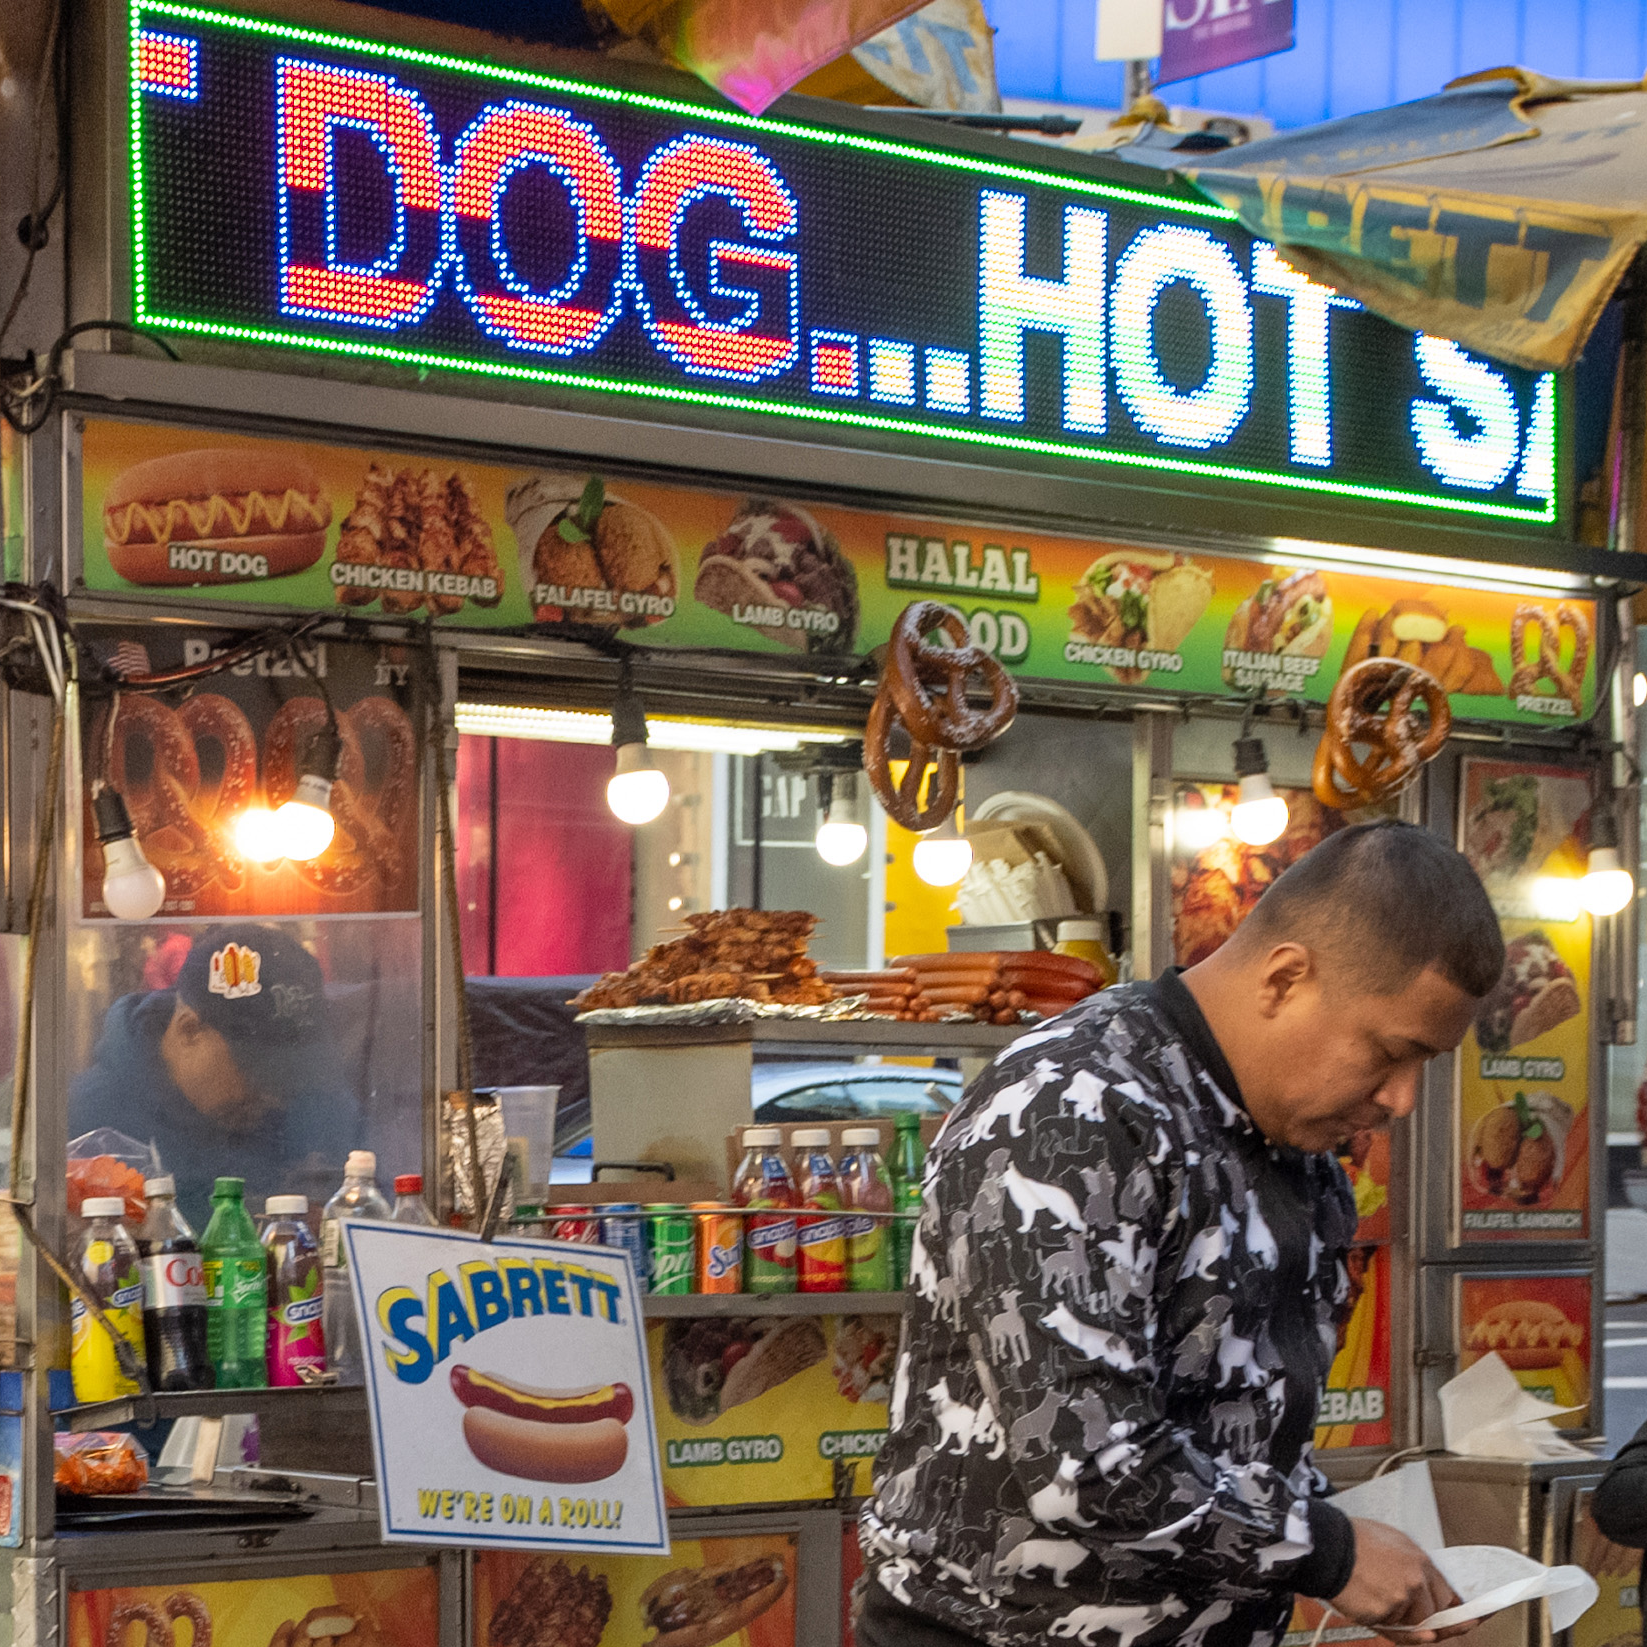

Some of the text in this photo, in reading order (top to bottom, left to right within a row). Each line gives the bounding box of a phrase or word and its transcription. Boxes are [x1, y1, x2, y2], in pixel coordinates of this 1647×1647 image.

[980, 189, 1364, 468] HOT
[169, 545, 269, 579] HOT DOG
[887, 536, 1039, 595] HALAL
[329, 562, 497, 599] CHICKEN KEBAB
[535, 583, 675, 617] FALAFEL GYRO
[732, 603, 840, 634] LAMB GYRO
[184, 638, 329, 680] Pretzel
[1063, 641, 1184, 673] CHICKEN GYRO
[1222, 648, 1321, 677] ITALIAN BEEF
[376, 1256, 622, 1386] SABRETT
[668, 1435, 782, 1466] LAMB GYRO
[417, 1488, 623, 1530] WE'RE ON A ROLL!
